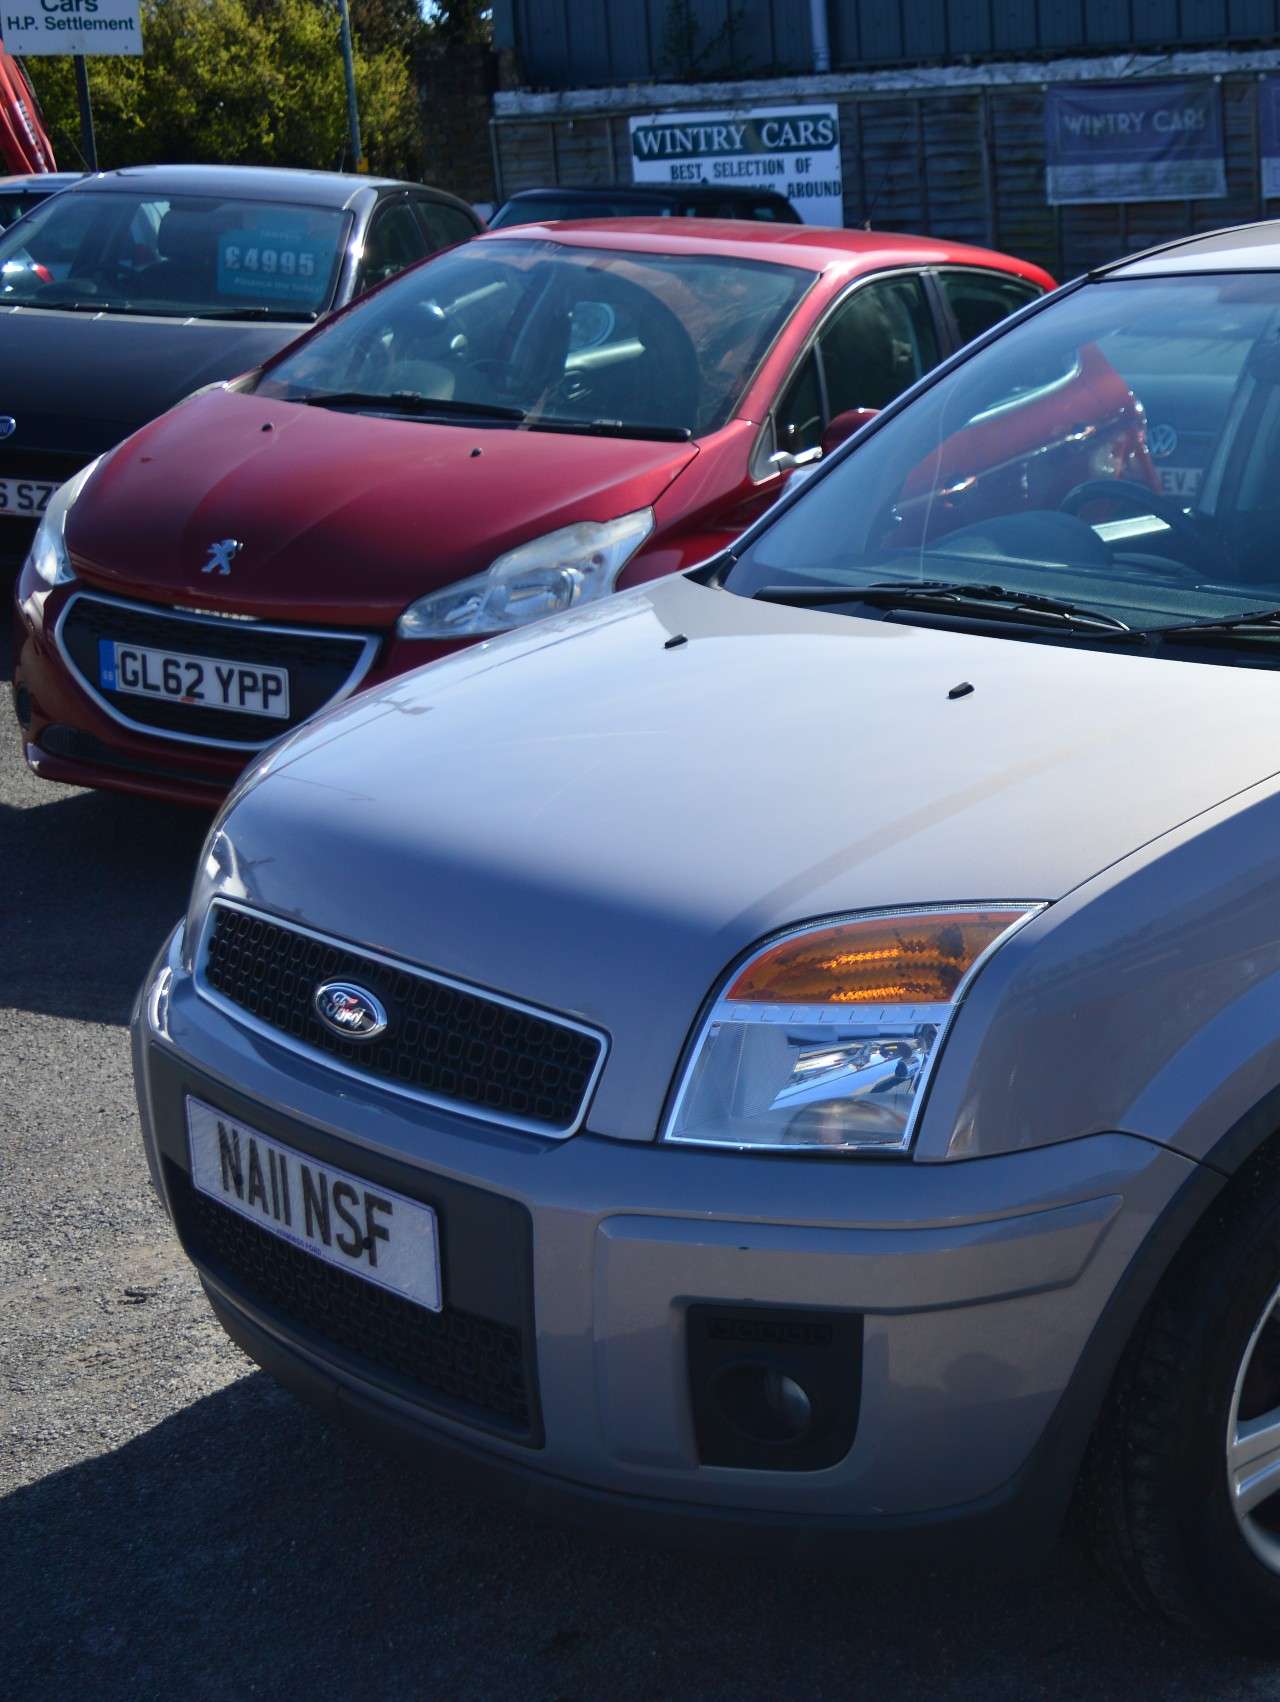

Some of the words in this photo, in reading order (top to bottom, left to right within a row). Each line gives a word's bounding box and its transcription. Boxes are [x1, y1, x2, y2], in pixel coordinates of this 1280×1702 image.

[41, 0, 99, 12] Cars
[7, 16, 39, 31] H.P.
[44, 16, 135, 31] Settlement
[1063, 112, 1145, 136] WINTRY
[636, 124, 746, 155] WINTRY
[761, 119, 834, 149] CARS
[670, 163, 703, 181] BEST
[713, 159, 785, 179] SELECTION
[795, 157, 812, 174] OF
[787, 180, 842, 199] AROUND
[225, 246, 315, 276] £4995
[120, 650, 205, 700] GL62
[215, 666, 283, 710] YPP
[301, 1164, 394, 1268] NSF
